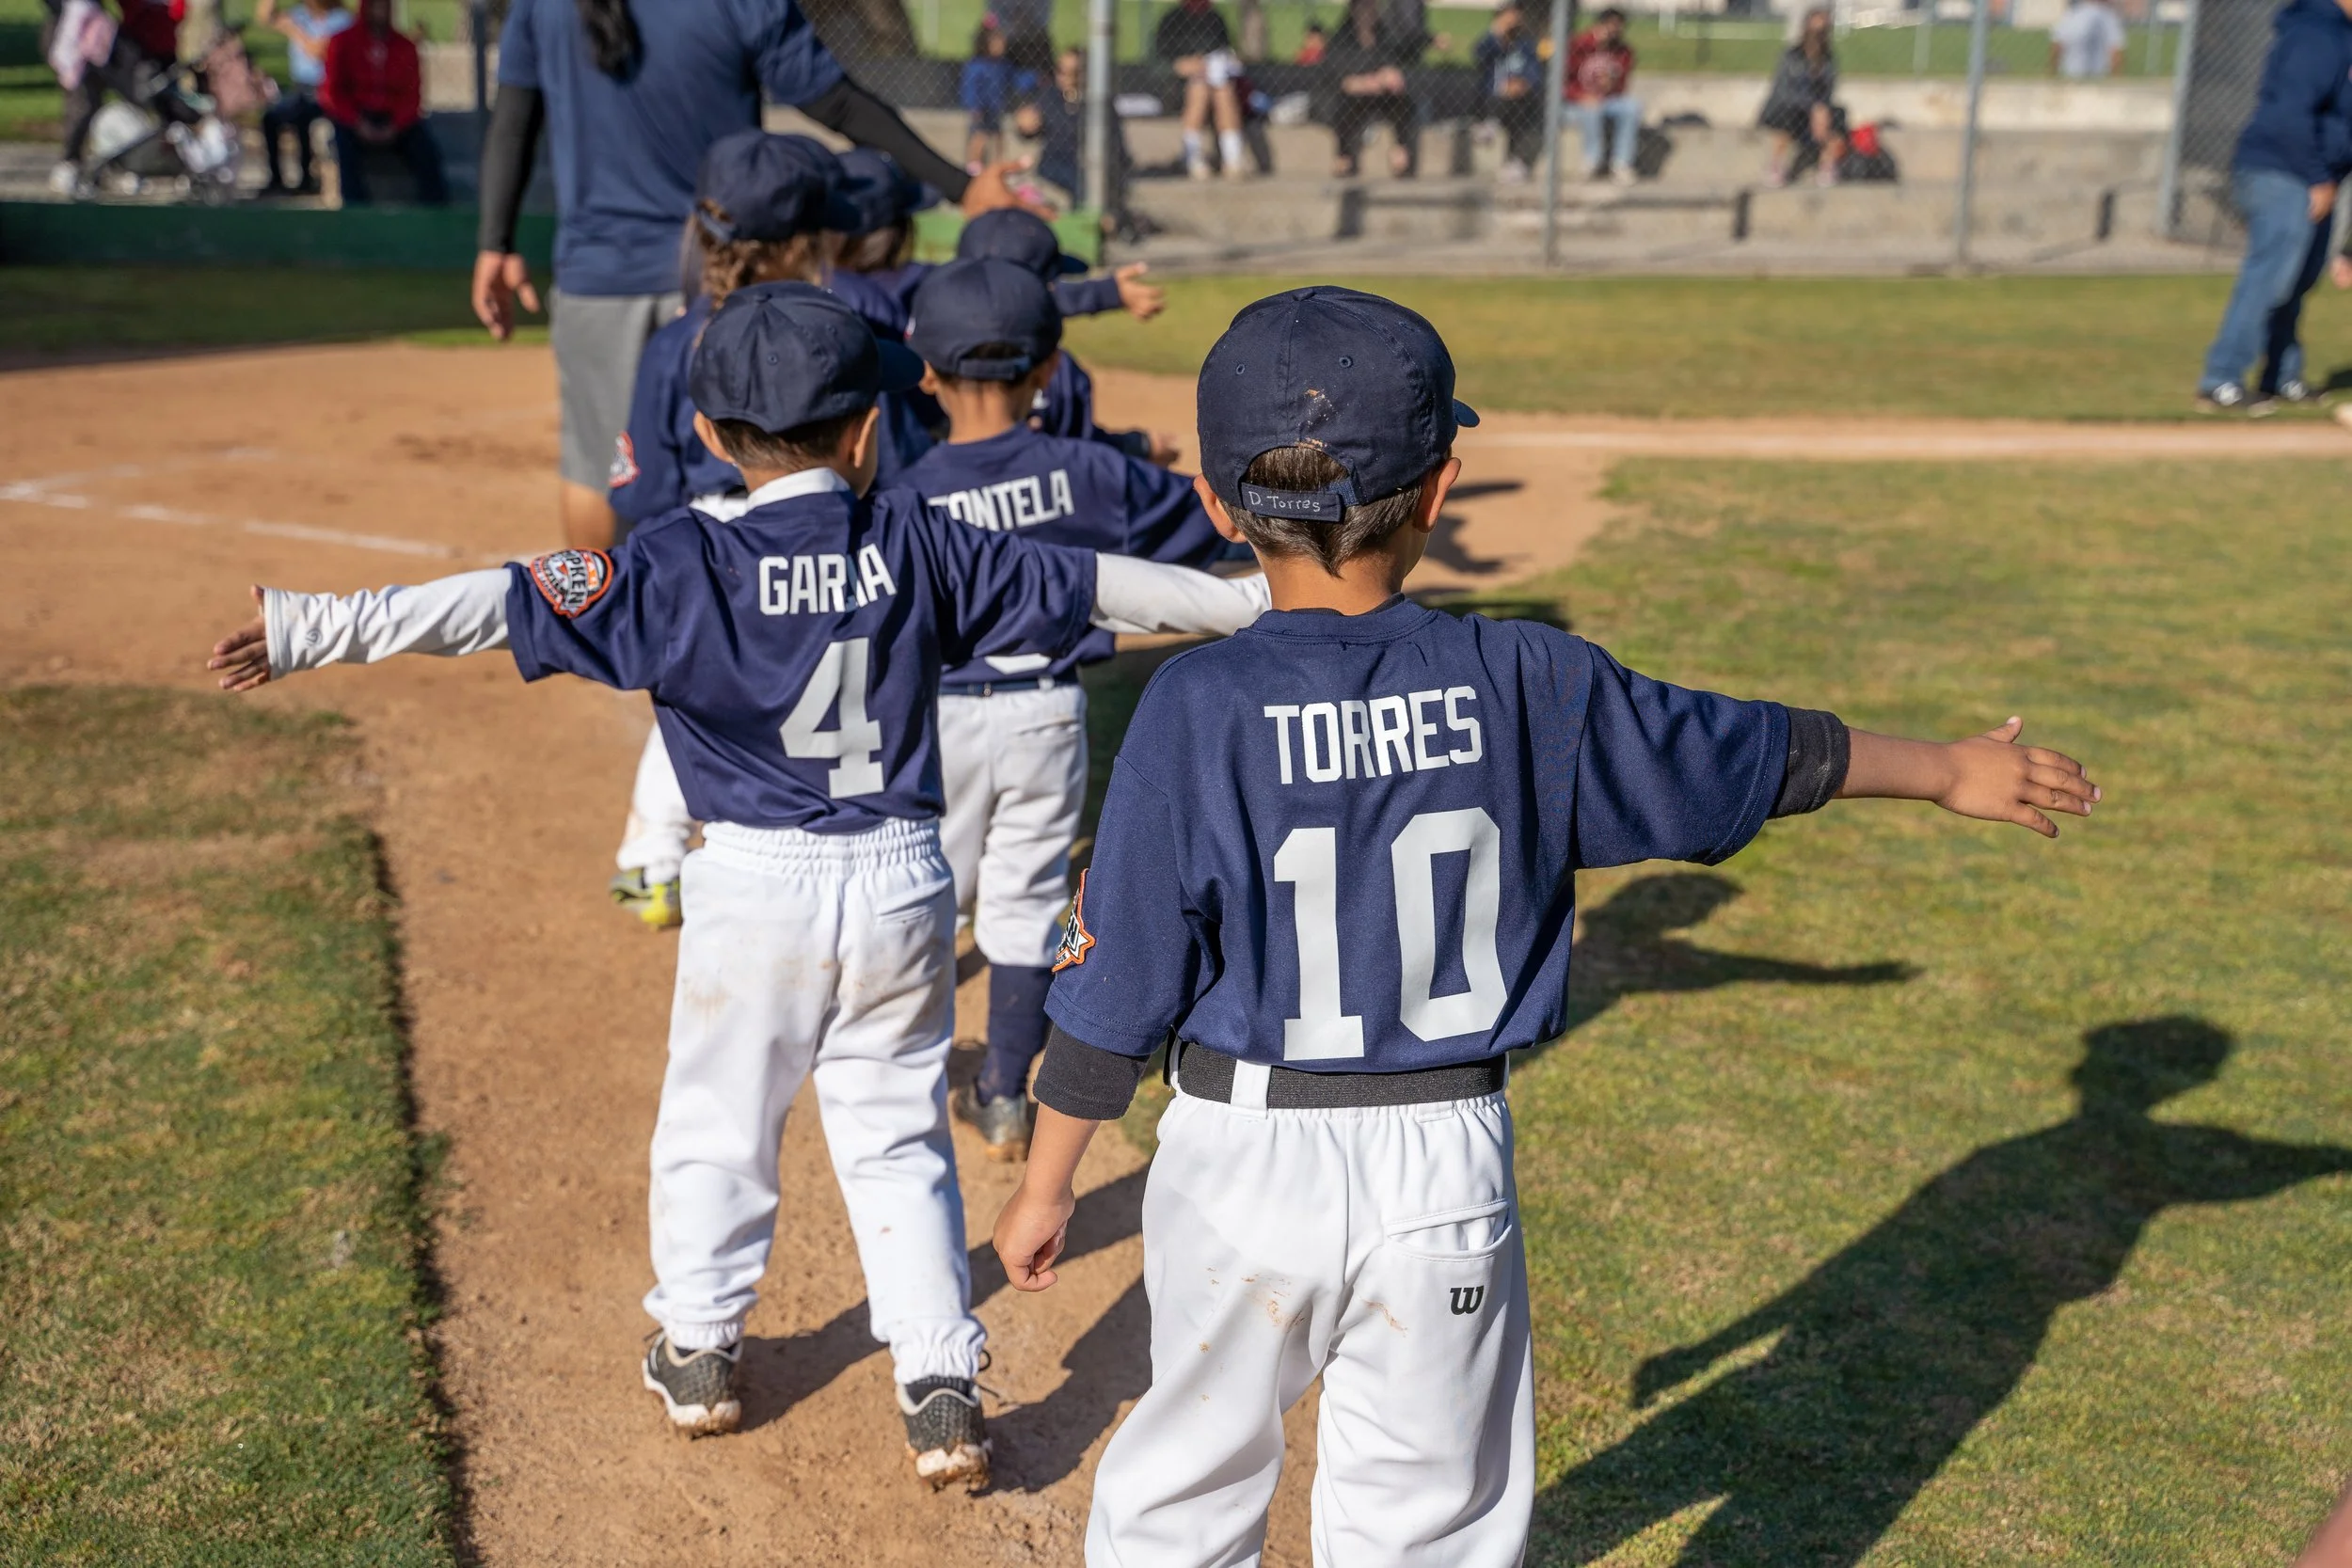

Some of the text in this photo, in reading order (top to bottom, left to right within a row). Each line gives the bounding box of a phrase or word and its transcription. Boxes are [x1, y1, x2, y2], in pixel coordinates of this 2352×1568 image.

[928, 469, 1075, 532] ONTELA
[1248, 491, 1321, 513] D. Torres
[780, 637, 884, 799] 4
[1263, 686, 1483, 784] TORRES
[1273, 807, 1507, 1061] 10
